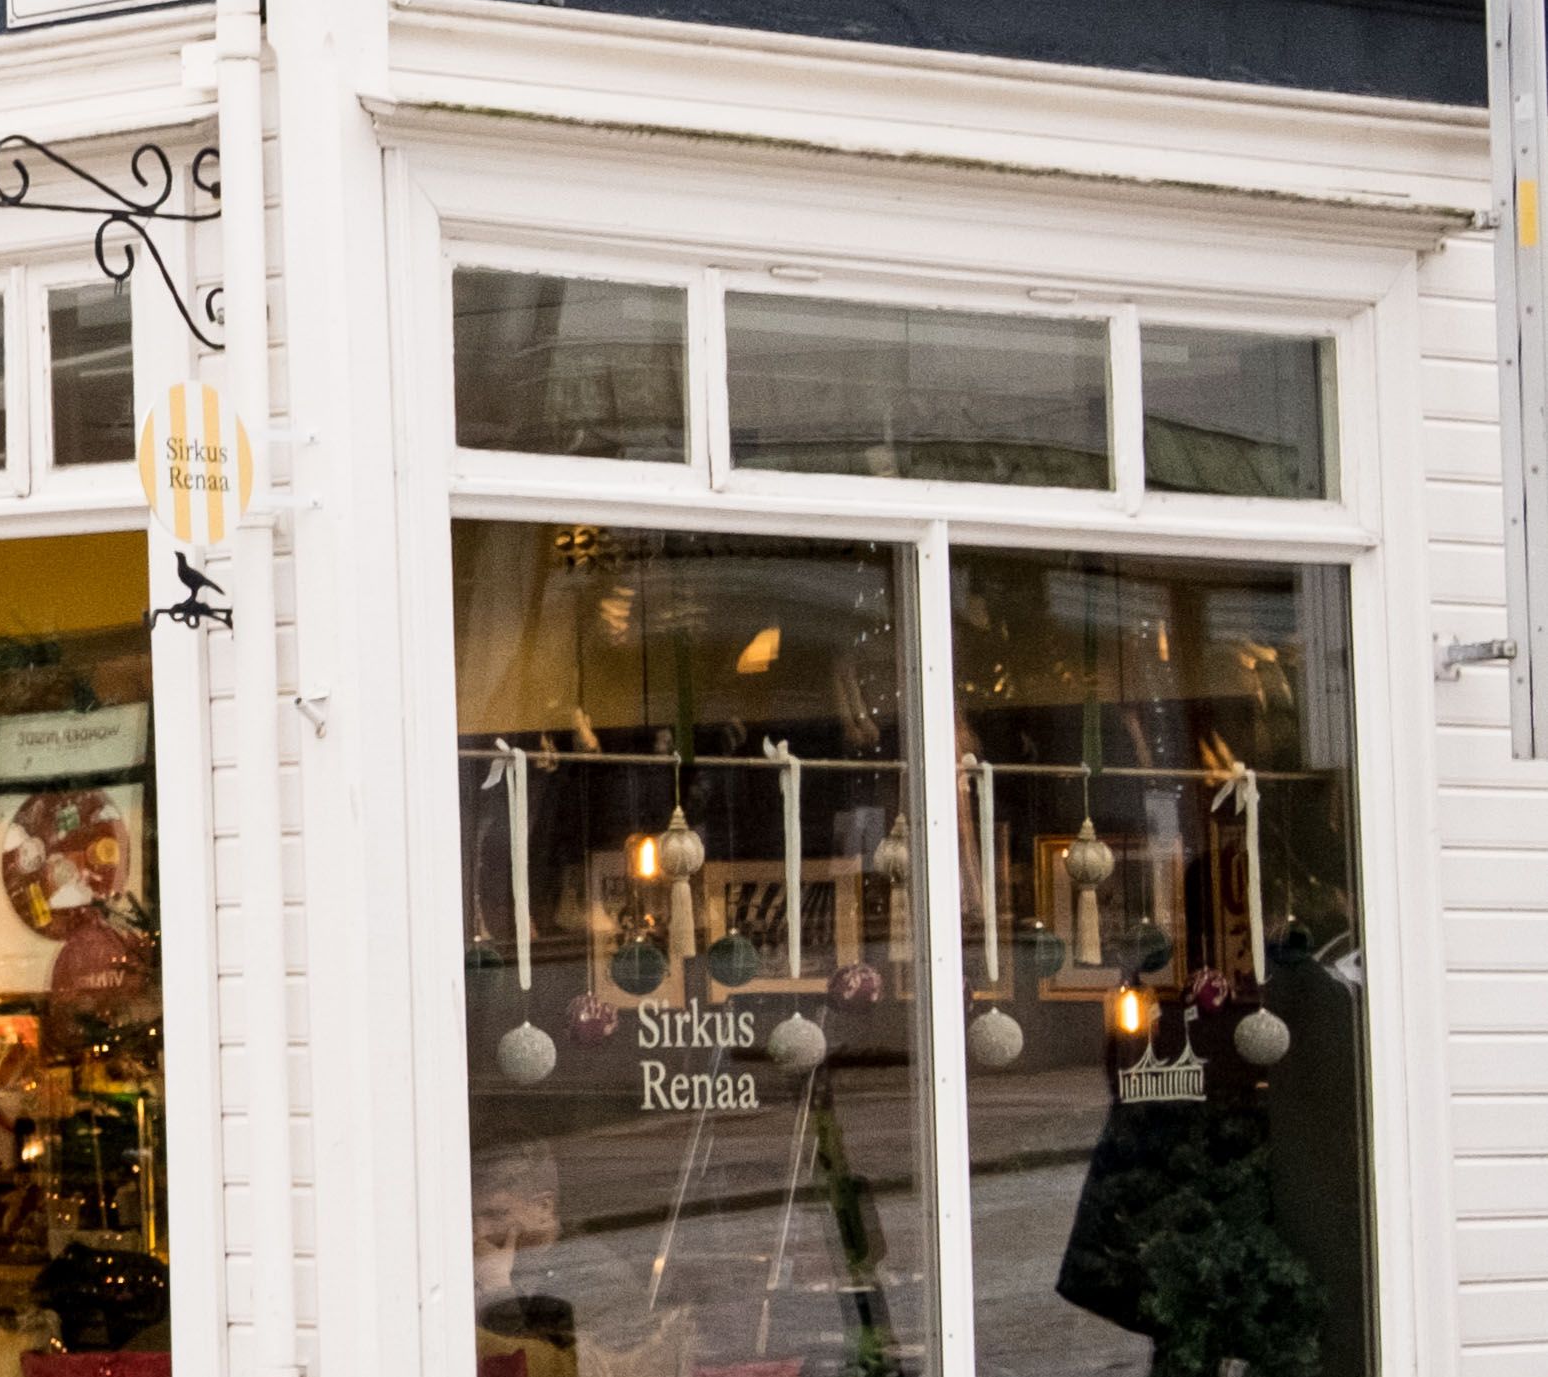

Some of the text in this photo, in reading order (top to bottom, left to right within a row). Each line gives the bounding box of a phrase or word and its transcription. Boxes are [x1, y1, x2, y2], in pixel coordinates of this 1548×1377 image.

[166, 438, 228, 463] Sirkus
[169, 466, 230, 492] Renaa
[638, 998, 755, 1049] Sirkus
[640, 1060, 759, 1111] Renaa
